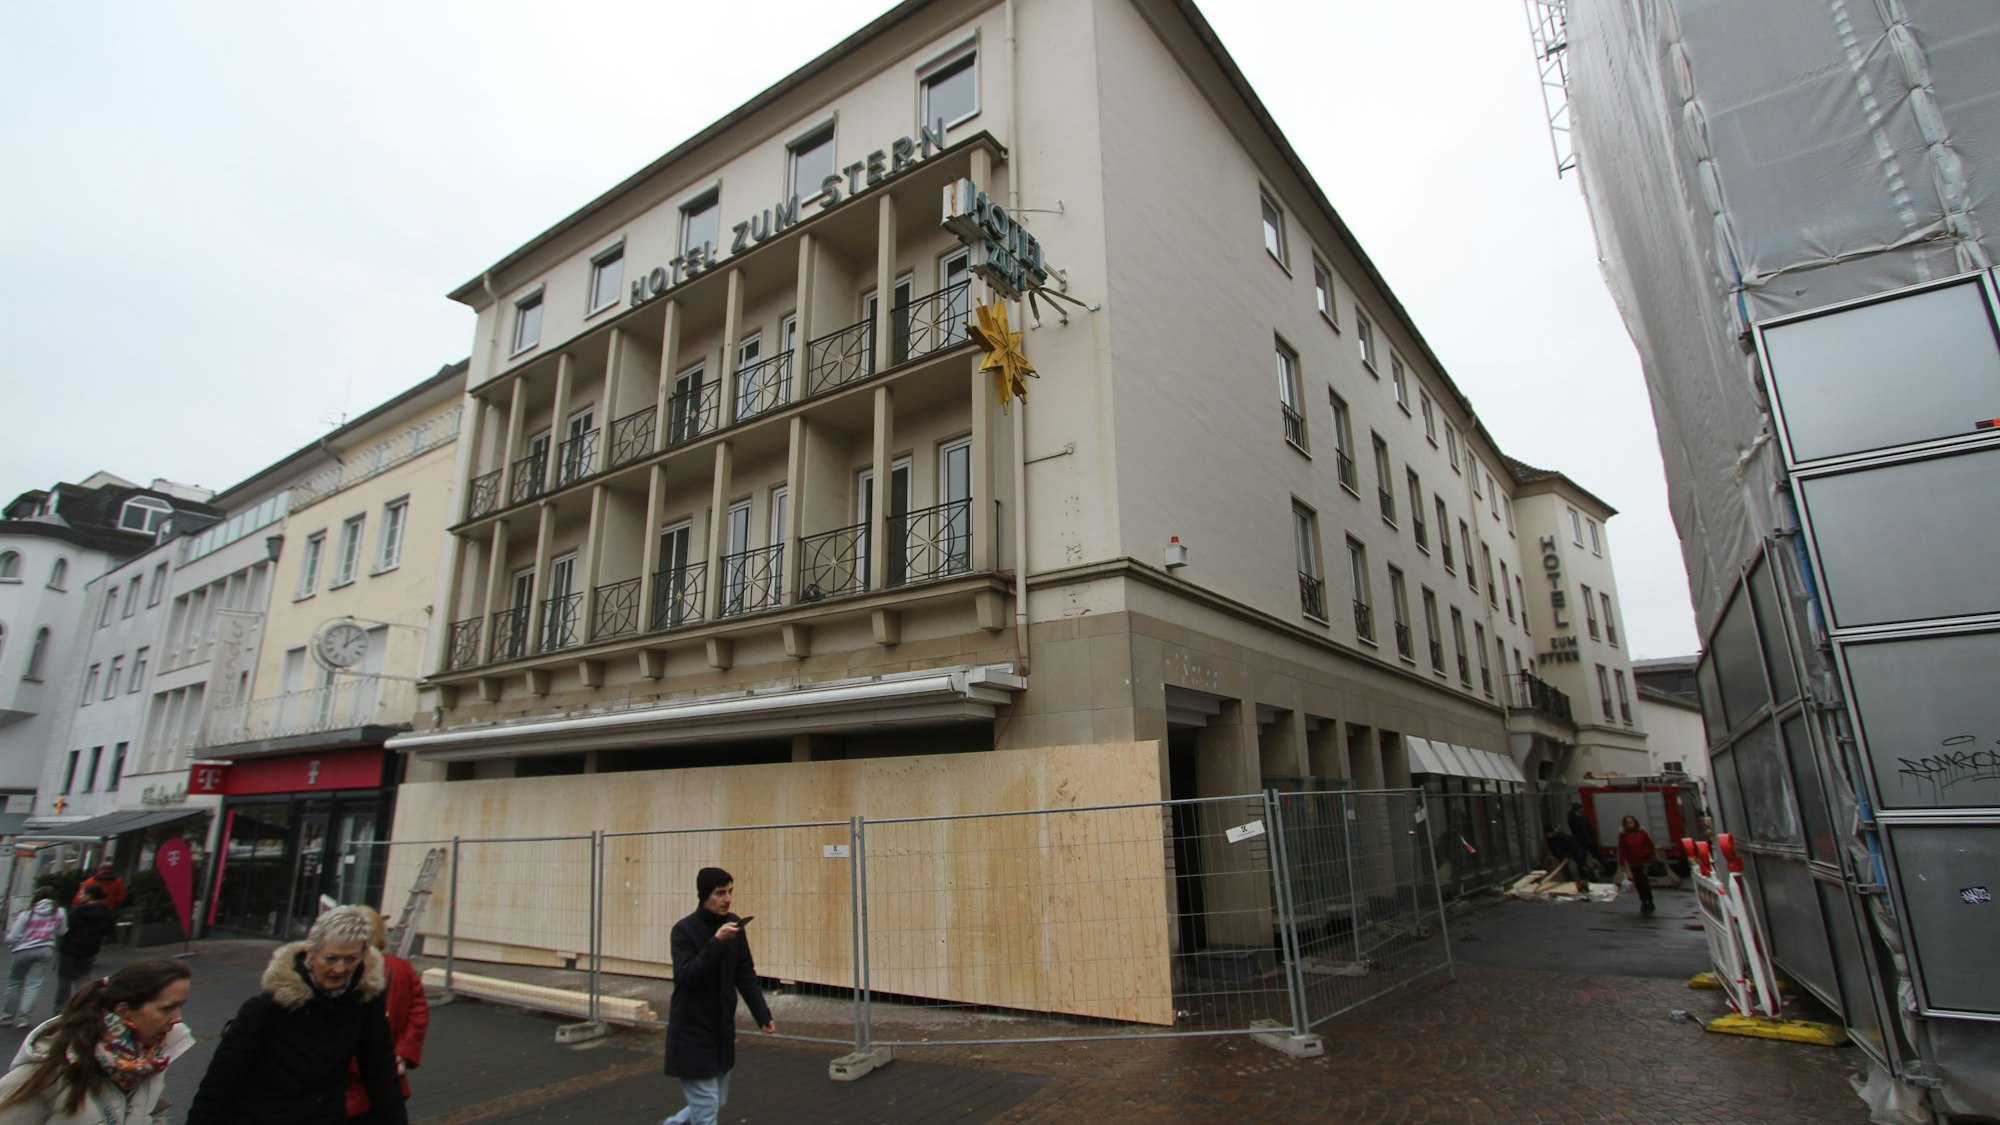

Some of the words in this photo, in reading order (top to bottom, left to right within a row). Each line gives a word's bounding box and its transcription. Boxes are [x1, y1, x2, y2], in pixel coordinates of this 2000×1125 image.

[630, 241, 717, 306] HOTEL
[731, 193, 799, 255] ZUM
[819, 116, 948, 209] STERN
[966, 180, 1048, 282] HOTEL
[985, 239, 1027, 292] ZUM
[1540, 535, 1569, 628] HOTEL
[1539, 651, 1579, 664] STERN
[1551, 636, 1577, 649] ZUM
[197, 768, 222, 791] T
[167, 850, 181, 866] T
